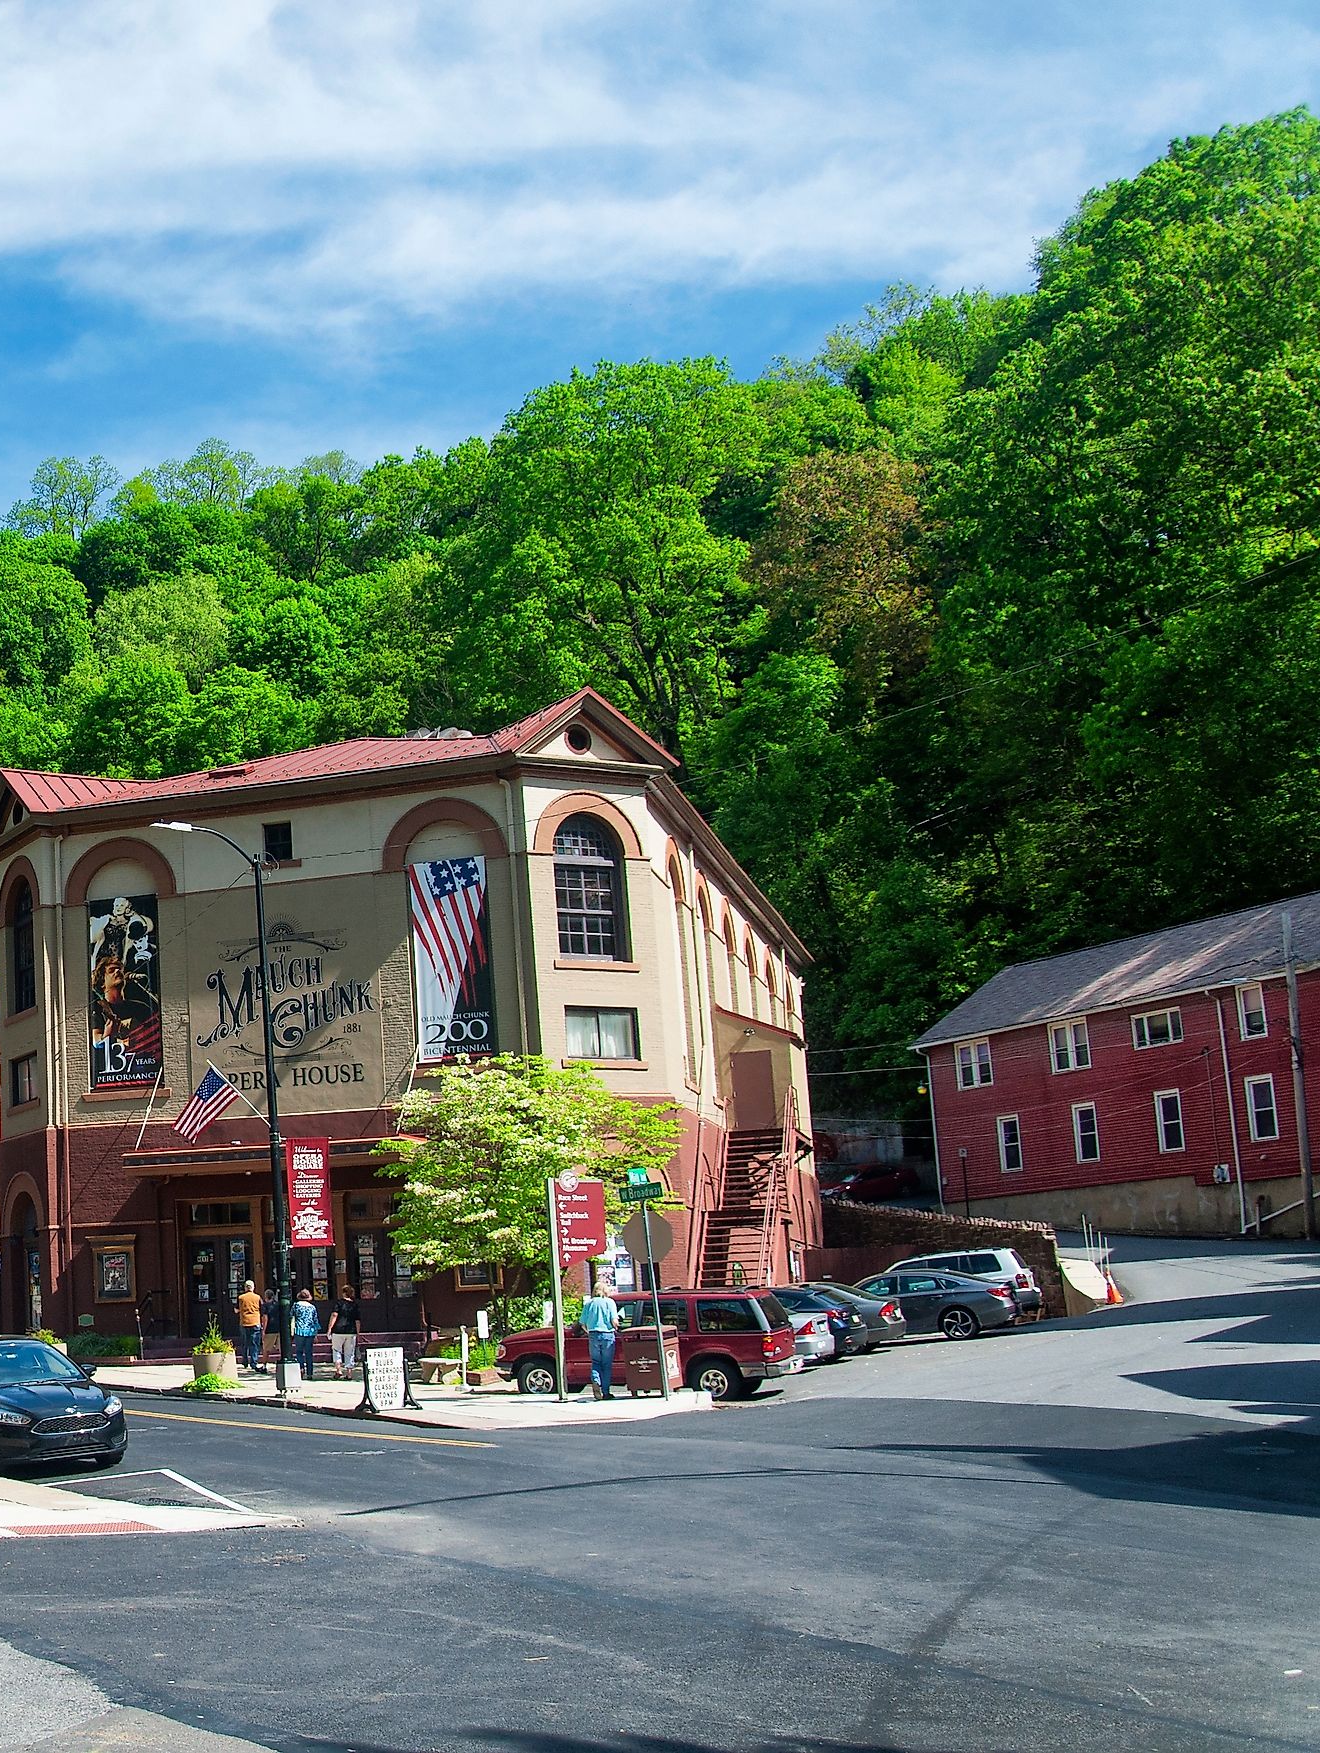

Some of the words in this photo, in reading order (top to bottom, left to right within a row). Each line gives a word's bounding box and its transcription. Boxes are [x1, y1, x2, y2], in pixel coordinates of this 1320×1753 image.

[272, 945, 292, 953] THE
[197, 953, 323, 1048] MAUCH
[268, 977, 377, 1050] CHUNK
[436, 1013, 462, 1021] MAUCH
[463, 1011, 490, 1019] CHUNK
[343, 1022, 362, 1034] 1881
[425, 1019, 489, 1045] 200
[94, 1036, 136, 1074] 137
[135, 1058, 156, 1066] YEARS
[423, 1043, 492, 1056] BICENTENNIAL
[292, 1063, 365, 1087] HOUSE
[572, 1194, 588, 1202] Street
[629, 1187, 661, 1199] Broadway
[375, 1358, 394, 1367] BLUES
[374, 1382, 398, 1391] CLASSIC
[374, 1391, 398, 1400] STONES
